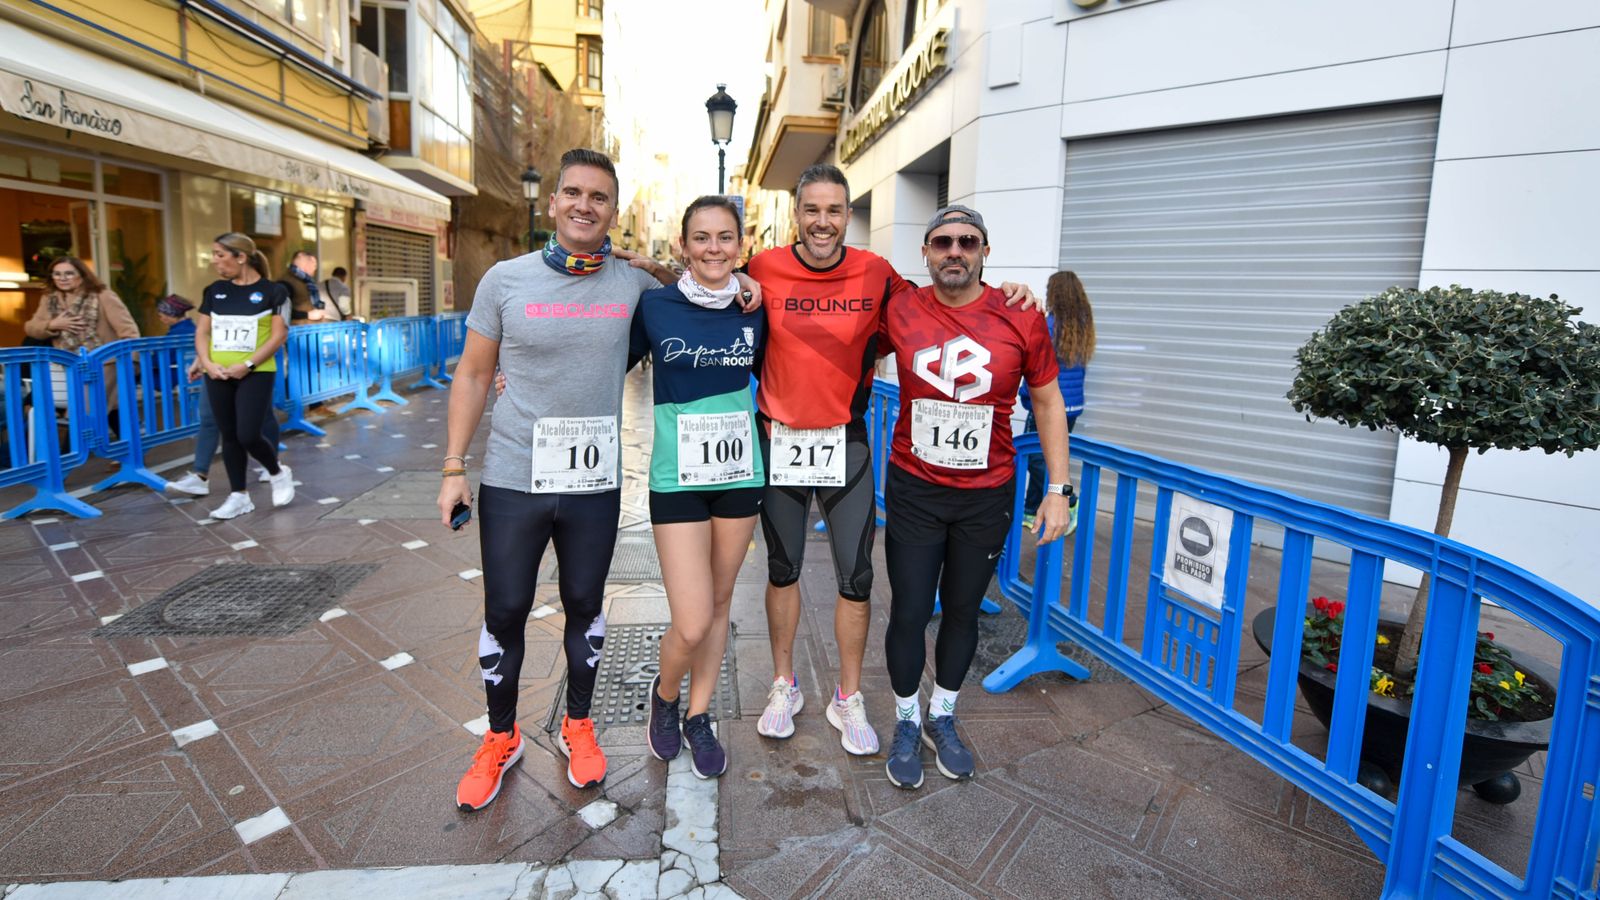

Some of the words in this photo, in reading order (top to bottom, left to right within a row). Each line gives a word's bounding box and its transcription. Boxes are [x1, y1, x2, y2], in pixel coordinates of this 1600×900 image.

[889, 28, 949, 111] CROOKE
[20, 80, 56, 119] San
[771, 298, 874, 312] DBOUNCE
[223, 329, 250, 341] 117
[660, 337, 755, 368] Deportes
[700, 437, 743, 465] 100
[931, 425, 978, 451] 146
[565, 444, 600, 470] 10
[789, 444, 835, 468] 217
[1176, 554, 1211, 574] PROHIBIDO
[1181, 564, 1189, 573] EL
[1190, 567, 1207, 580] PASO
